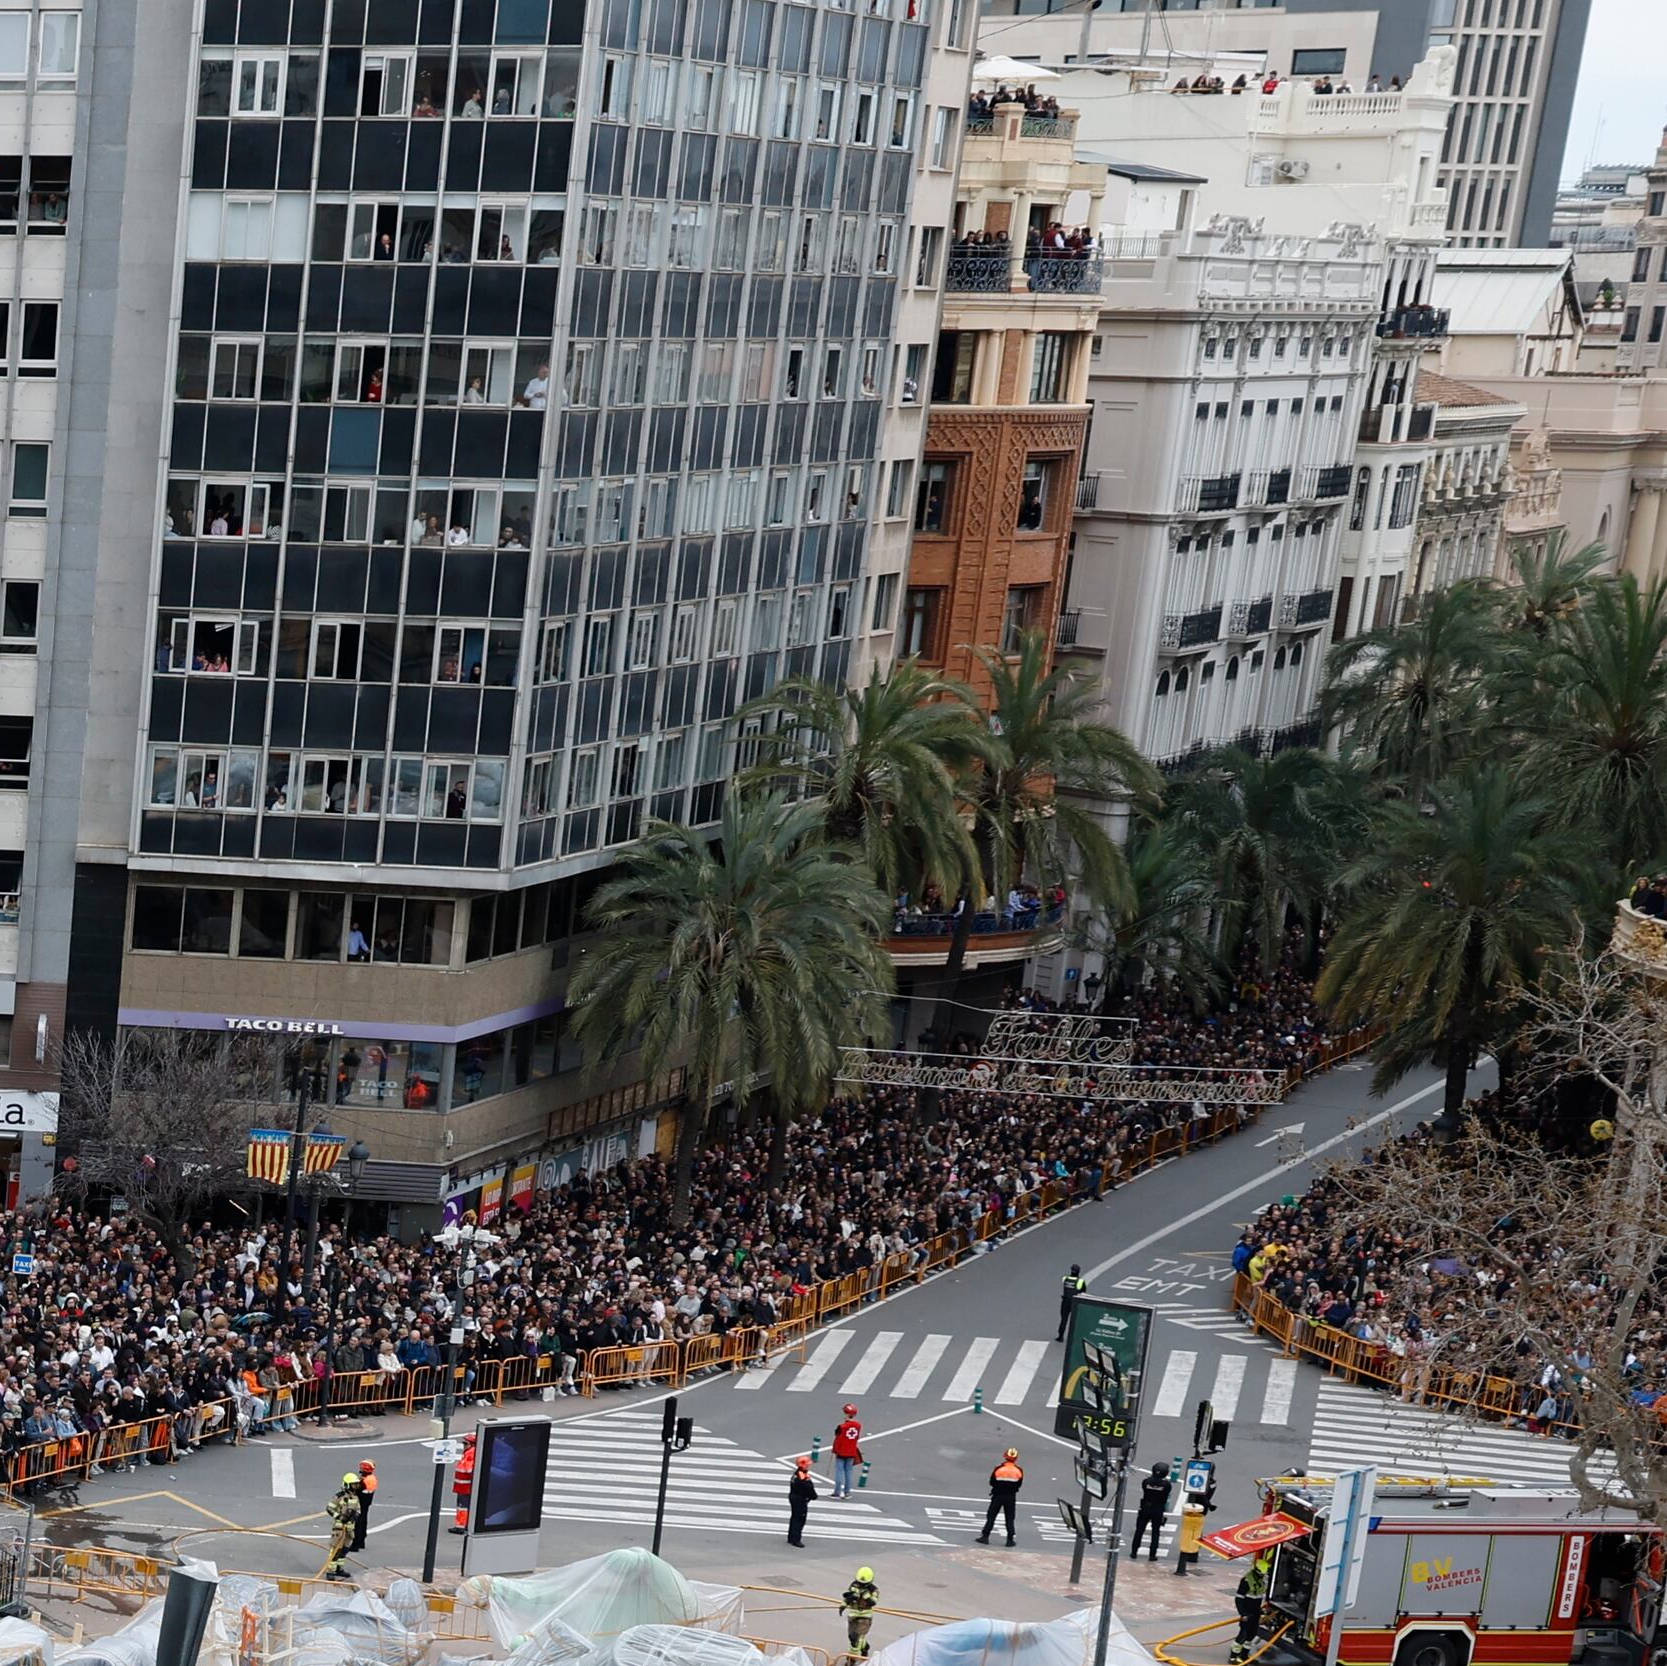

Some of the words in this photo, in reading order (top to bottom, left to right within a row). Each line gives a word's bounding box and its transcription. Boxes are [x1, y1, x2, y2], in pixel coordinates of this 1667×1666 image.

[225, 1018, 283, 1031] TACO
[287, 1022, 345, 1035] BELL
[358, 1079, 399, 1089] TACO
[359, 1088, 399, 1098] BELL
[15, 1258, 33, 1270] TAXI
[1146, 1258, 1237, 1282] TAXI
[1110, 1275, 1208, 1297] EMT
[1426, 1567, 1482, 1585] BOMBERS
[1560, 1541, 1581, 1614] BOMBERS
